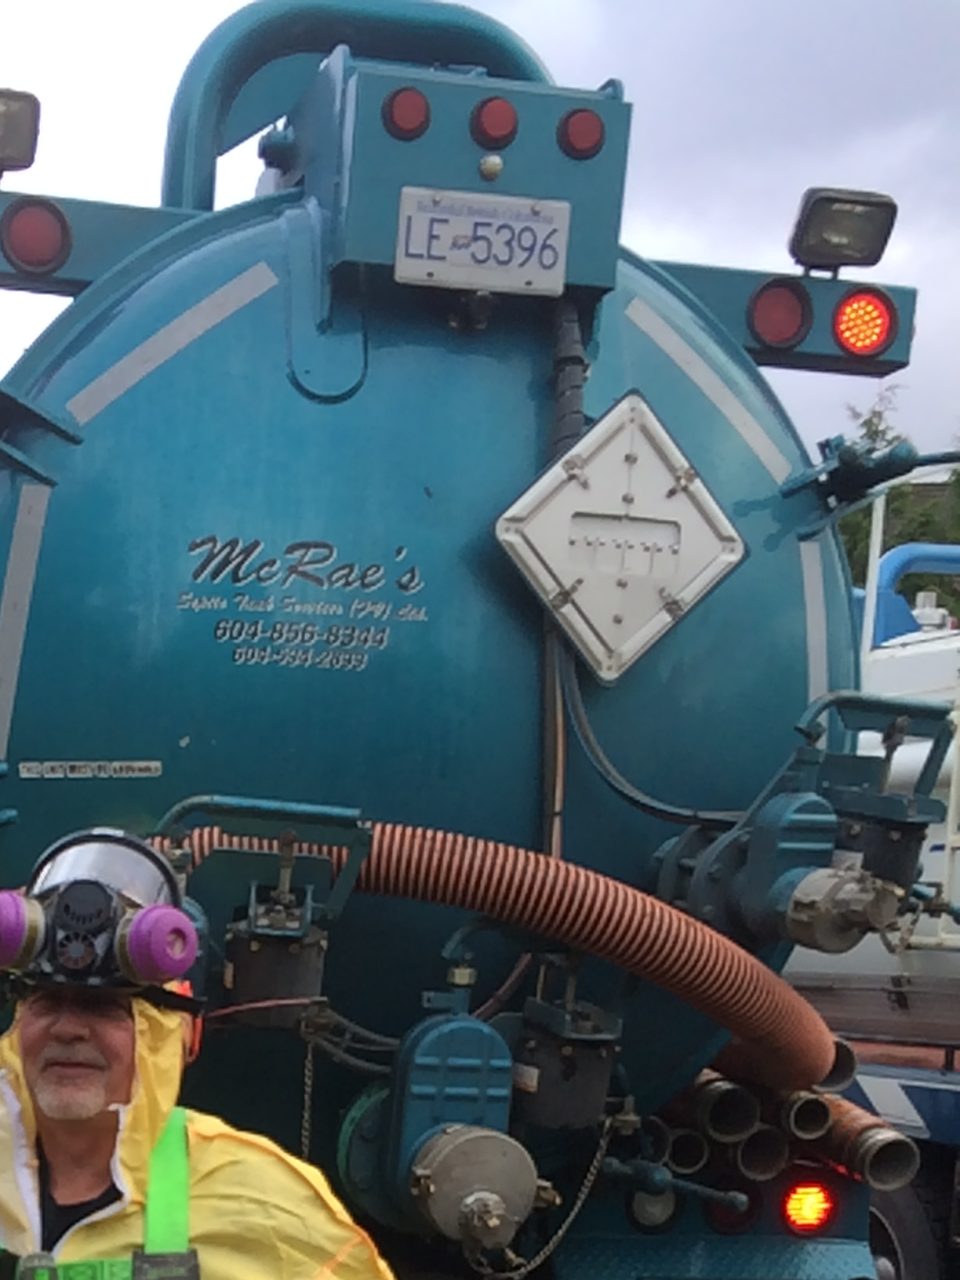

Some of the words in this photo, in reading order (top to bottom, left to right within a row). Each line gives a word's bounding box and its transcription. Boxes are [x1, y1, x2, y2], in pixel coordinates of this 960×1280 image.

[404, 215, 450, 261] LE
[470, 221, 560, 271] 5396
[187, 534, 425, 594] McRae's
